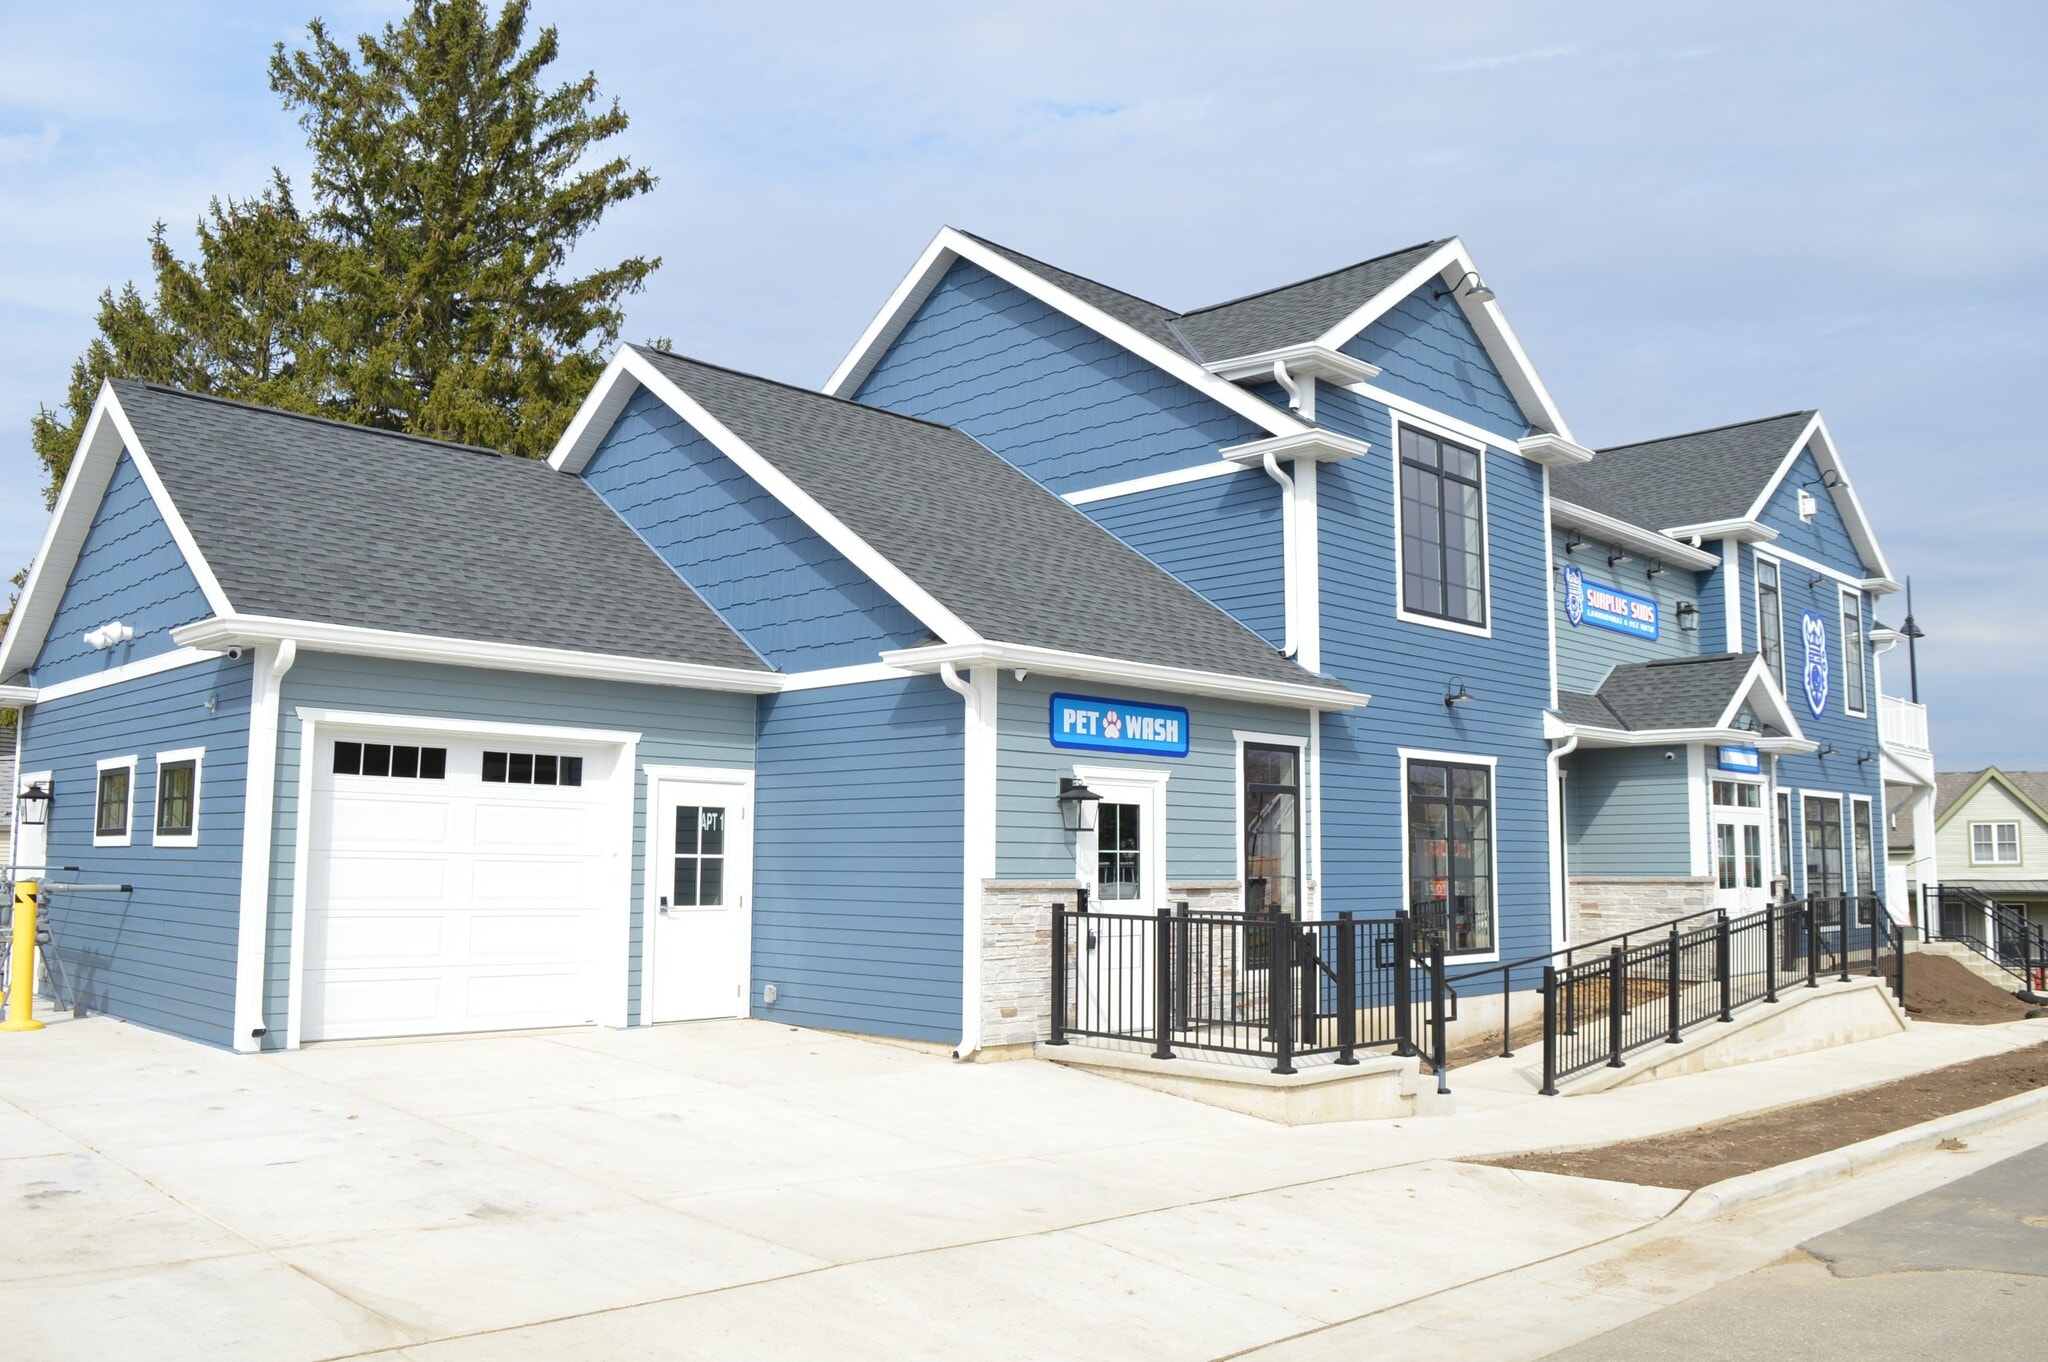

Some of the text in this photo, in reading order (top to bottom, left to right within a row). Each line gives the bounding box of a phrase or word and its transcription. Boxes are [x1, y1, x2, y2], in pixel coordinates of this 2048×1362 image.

[1586, 589, 1655, 623] SURPLUS SUDS
[1063, 708, 1179, 743] PET WASH
[702, 812, 724, 831] APT 1
